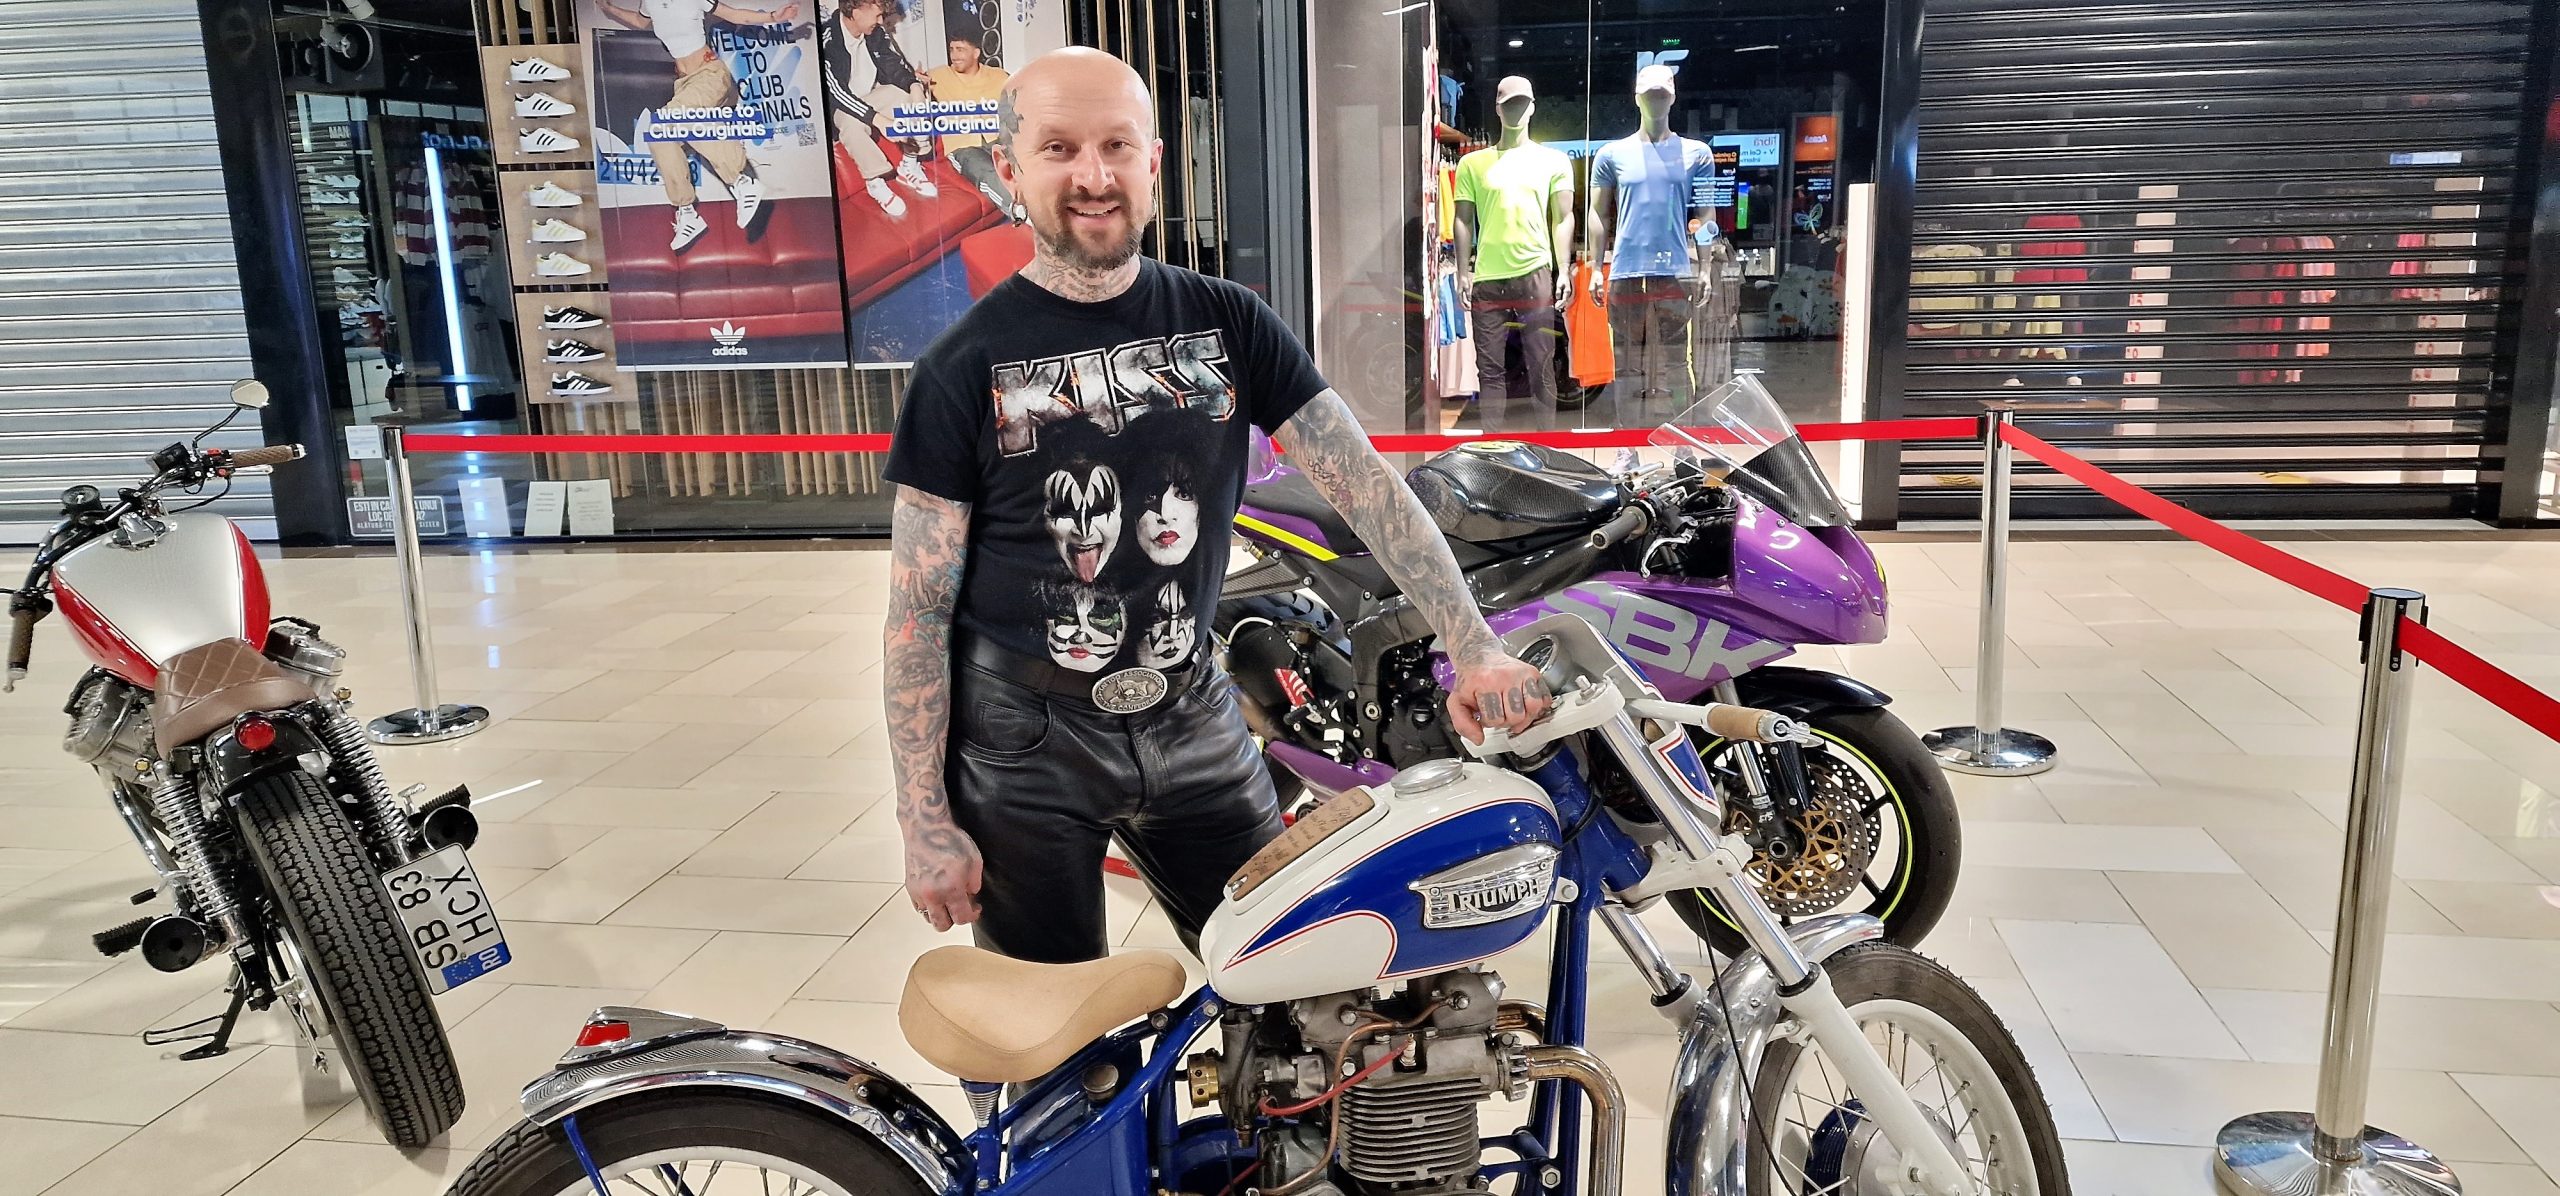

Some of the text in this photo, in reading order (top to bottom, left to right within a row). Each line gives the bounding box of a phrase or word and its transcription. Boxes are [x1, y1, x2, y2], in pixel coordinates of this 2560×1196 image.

[741, 51, 767, 74] TO
[738, 75, 784, 101] CLUB
[656, 104, 754, 120] welcome to
[901, 97, 999, 115] welcome to
[649, 121, 766, 140] Club Originals
[893, 114, 999, 134] Club Original
[712, 346, 749, 356] adidas
[992, 329, 1236, 457] KISS
[1537, 581, 1793, 681] SBK
[433, 865, 494, 944] HCX
[1446, 878, 1541, 914] TRIUMPH
[389, 870, 458, 969] SB 83
[478, 947, 502, 971] RO
